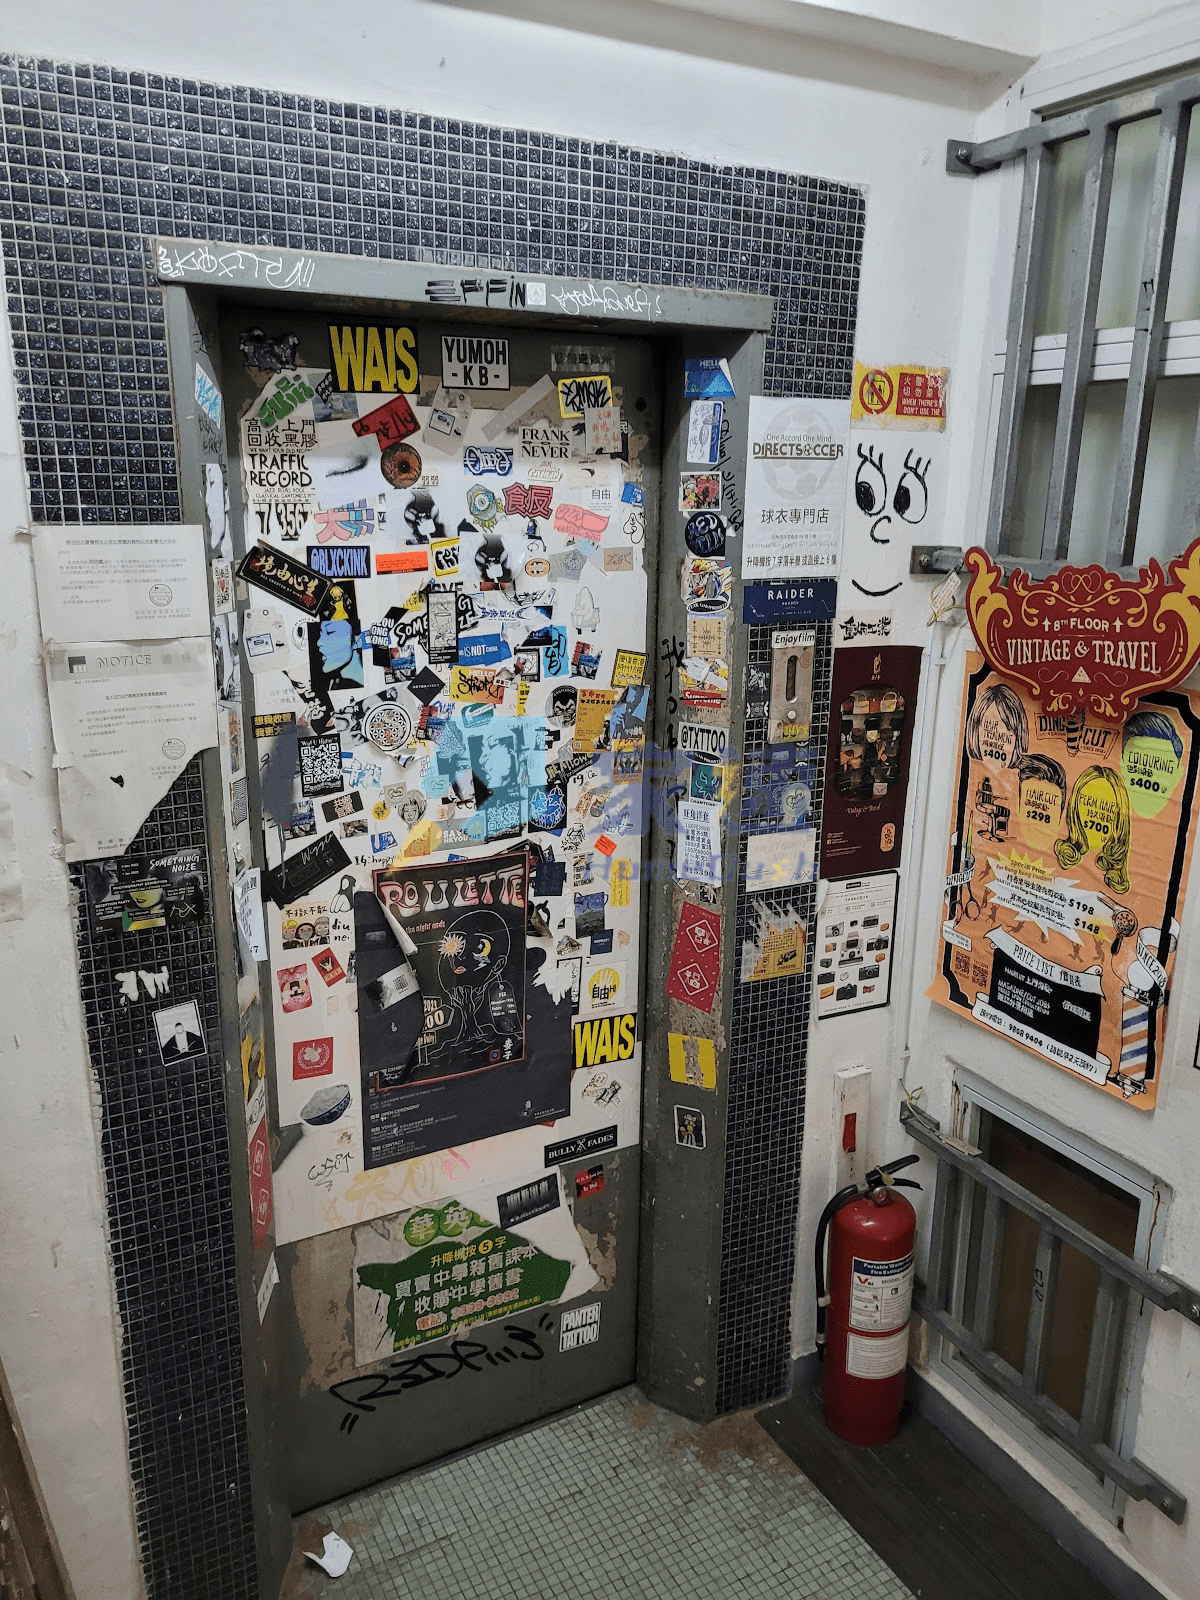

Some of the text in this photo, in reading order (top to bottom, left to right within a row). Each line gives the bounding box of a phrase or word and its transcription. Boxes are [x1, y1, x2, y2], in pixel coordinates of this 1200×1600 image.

[329, 325, 418, 394] WAIS
[443, 337, 507, 366] YUMOH
[902, 399, 938, 408] WHEN THERE'S
[903, 406, 941, 416] DON'T USE THE
[245, 418, 317, 433] 高上門
[247, 434, 318, 448] 回收黑膠
[521, 428, 570, 442] FRANK
[766, 433, 832, 443] One Accord One Mind
[521, 445, 569, 459] NEVER
[752, 442, 844, 459] DIRECTSOCCER
[248, 454, 309, 470] TRAFFIC
[250, 470, 313, 487] RECORD
[591, 488, 611, 500] 自由
[761, 508, 830, 524] 球衣專門店
[310, 548, 368, 577] @BLXCKINK
[767, 587, 814, 600] RAIDER
[1070, 617, 1110, 632] FLOOR
[774, 631, 815, 645] Enjoyfilm
[471, 644, 486, 656] NOT
[1006, 637, 1162, 675] VINTAGE & TRAVEL
[97, 654, 152, 669] NOTICE
[468, 669, 495, 678] HELLO
[983, 718, 999, 731] HAIR
[681, 725, 726, 754] @TXTTOO
[1082, 727, 1111, 747] CUT
[983, 749, 1007, 762] $400
[1127, 751, 1175, 774] COLOURING
[1129, 778, 1160, 793] $400
[1026, 788, 1059, 806] HAIR CUT
[1078, 793, 1116, 815] PERM HAIR
[1026, 810, 1052, 824] $298
[443, 827, 469, 839] SAVE
[1083, 819, 1109, 835] $700
[149, 854, 200, 870] SOMETHING
[172, 862, 197, 874] NOIZE
[378, 863, 525, 918] ROULETTE
[1068, 897, 1096, 916] $198
[1074, 917, 1100, 935] $148
[1013, 943, 1036, 968] PRICE
[1036, 957, 1055, 978] LIST
[574, 1013, 636, 1068] WAIS
[548, 1132, 615, 1160] BULLY FADES
[430, 1235, 507, 1269] 升降機按5字
[394, 1243, 539, 1300] 買賣中學新舊課本
[863, 1262, 888, 1270] Portable
[413, 1267, 525, 1315] 收購中學舊書
[562, 1304, 600, 1330] PANTER
[562, 1325, 599, 1351] TATTOO
